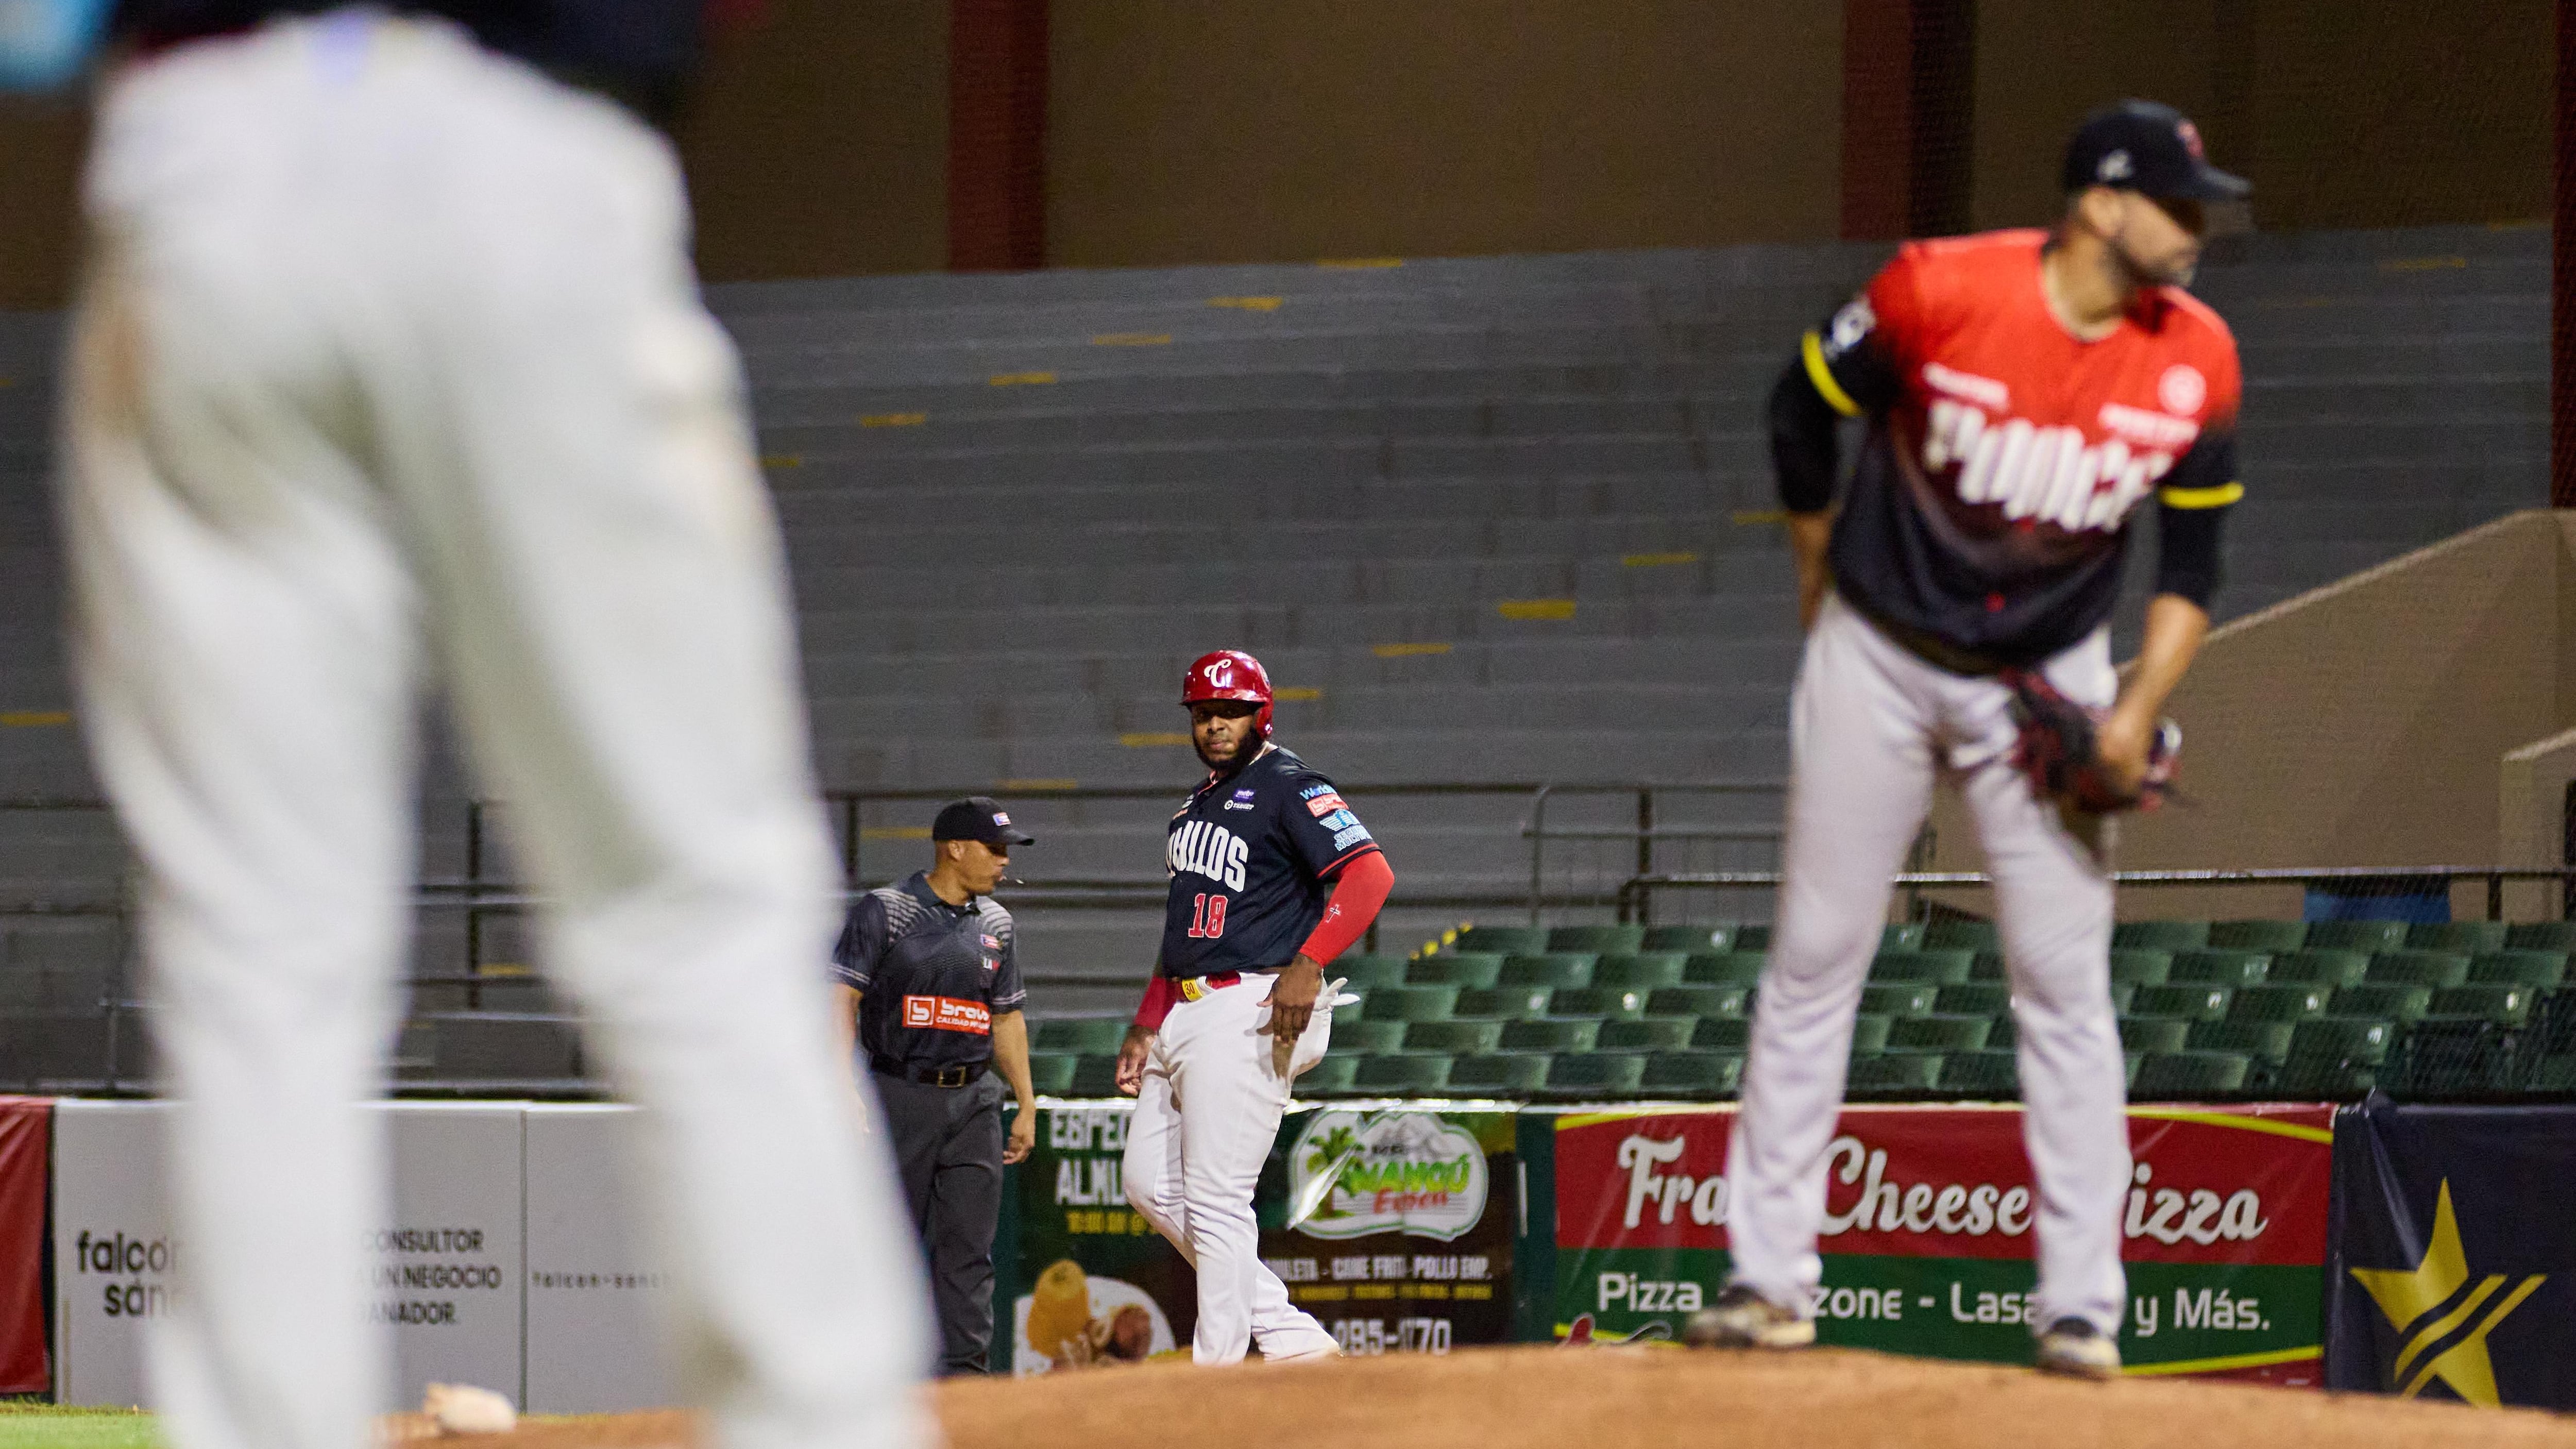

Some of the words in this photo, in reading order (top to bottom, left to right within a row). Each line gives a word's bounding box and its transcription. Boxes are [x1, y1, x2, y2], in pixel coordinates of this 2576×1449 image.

[1188, 893, 1228, 938] 18
[1185, 982, 1195, 995] 30
[1618, 1135, 1730, 1229] Fra
[1818, 1136, 2031, 1236] Cheese
[2125, 1162, 2269, 1245] izza
[1598, 1272, 1703, 1313] Pizza
[1812, 1285, 1902, 1319] zone
[1951, 1282, 2038, 1324] Lasa
[2134, 1295, 2158, 1337] y
[2175, 1288, 2270, 1330] Más.
